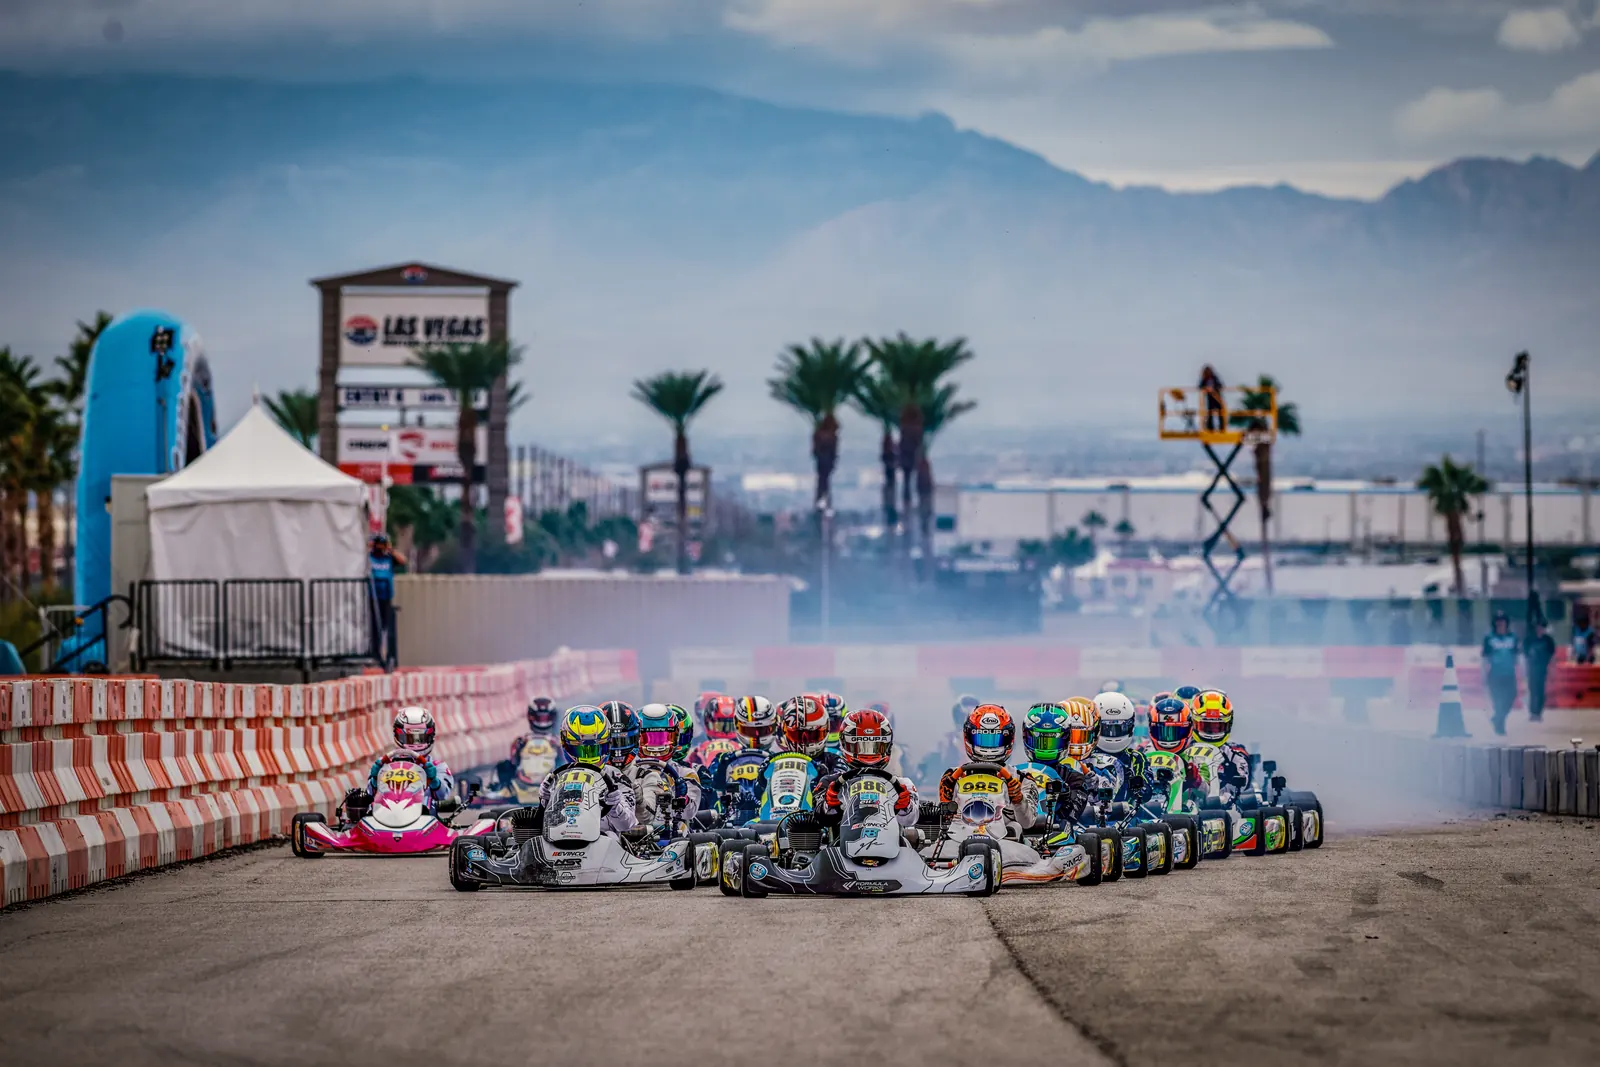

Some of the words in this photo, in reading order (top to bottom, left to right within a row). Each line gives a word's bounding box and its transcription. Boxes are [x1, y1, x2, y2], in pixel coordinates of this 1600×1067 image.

[384, 315, 418, 336] LAS
[423, 315, 484, 337] VEGAS
[981, 717, 999, 725] Arai
[385, 769, 415, 780] 946
[558, 771, 592, 784] 911
[852, 780, 886, 794] 986
[962, 781, 999, 793] 985
